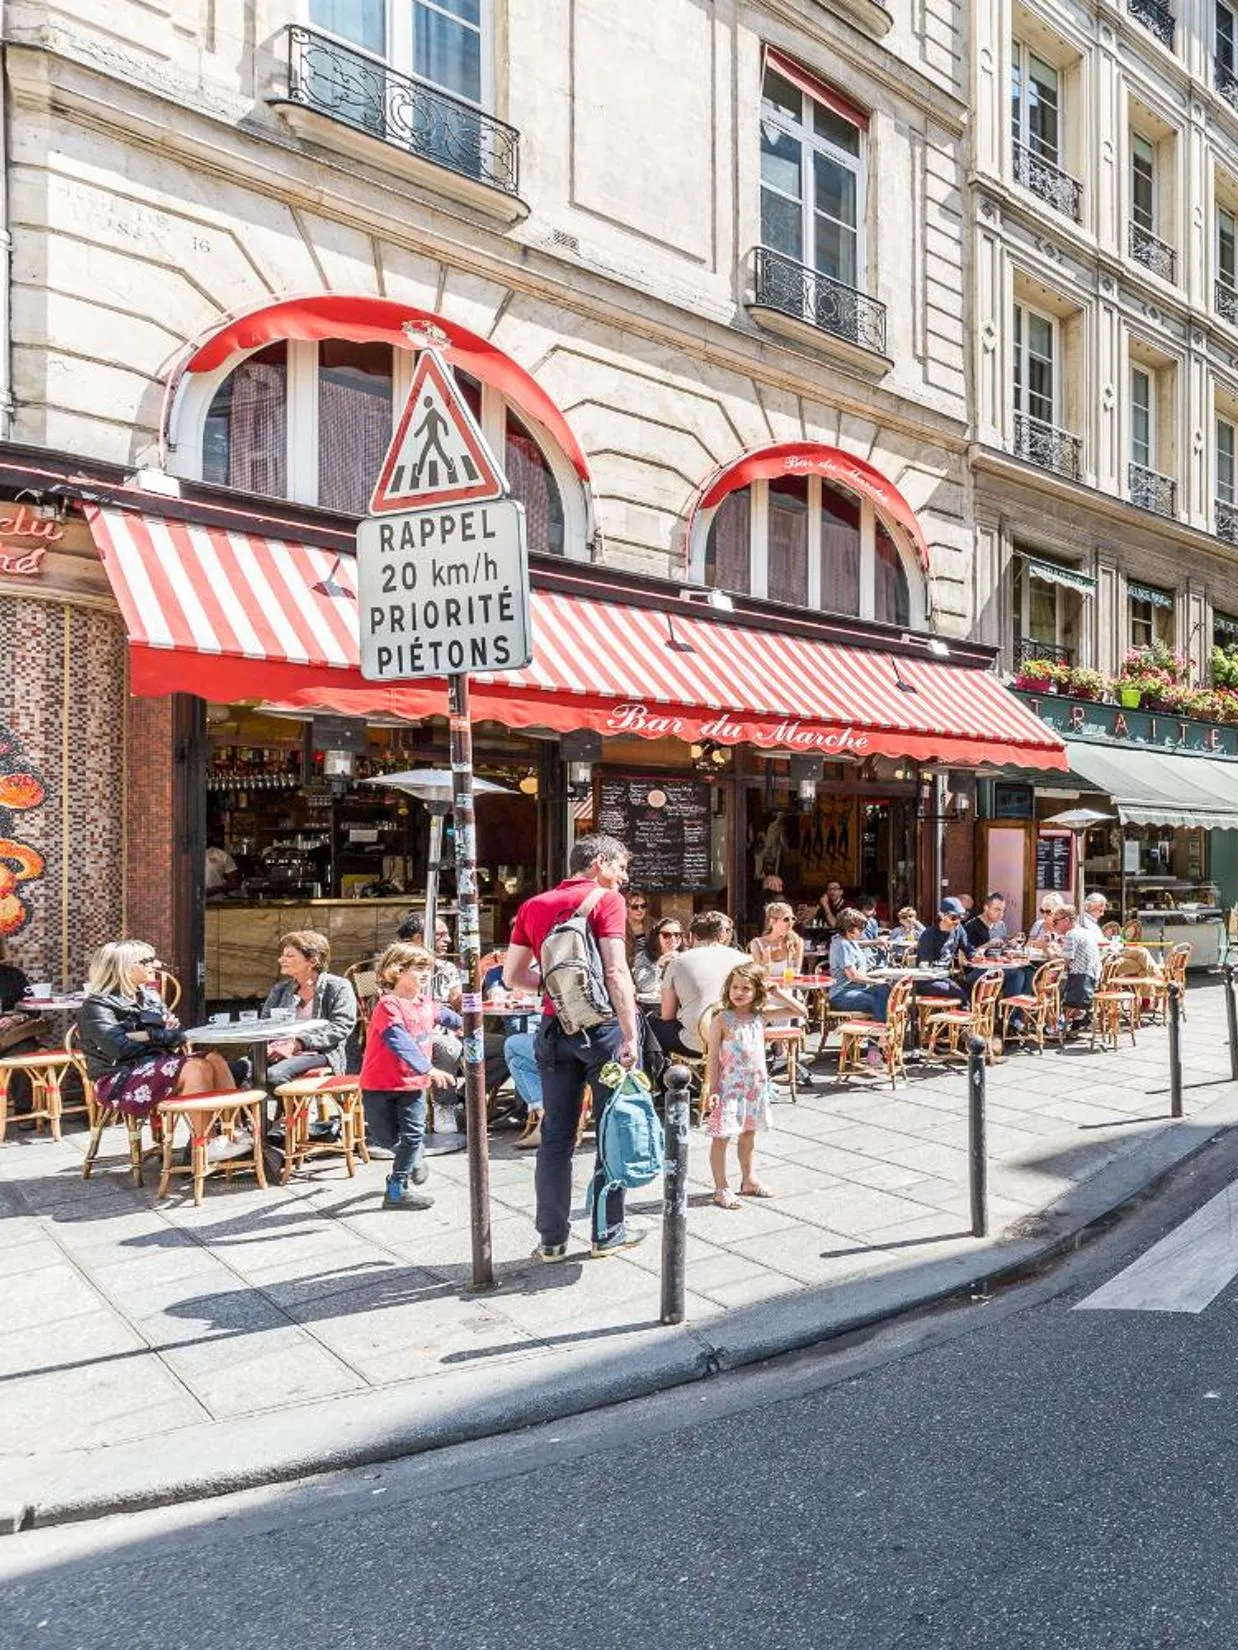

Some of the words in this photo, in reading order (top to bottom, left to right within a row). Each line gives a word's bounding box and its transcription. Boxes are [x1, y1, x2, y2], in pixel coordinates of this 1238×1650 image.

[784, 456, 814, 469] Bar
[379, 509, 496, 552] RAPPEL
[382, 561, 417, 593] 20
[431, 552, 498, 587] km/h
[370, 585, 514, 634] PRIORITÉ
[377, 635, 511, 675] PIÉTONS
[607, 703, 685, 734] Bar
[698, 713, 742, 739] du
[756, 720, 870, 749] Marché
